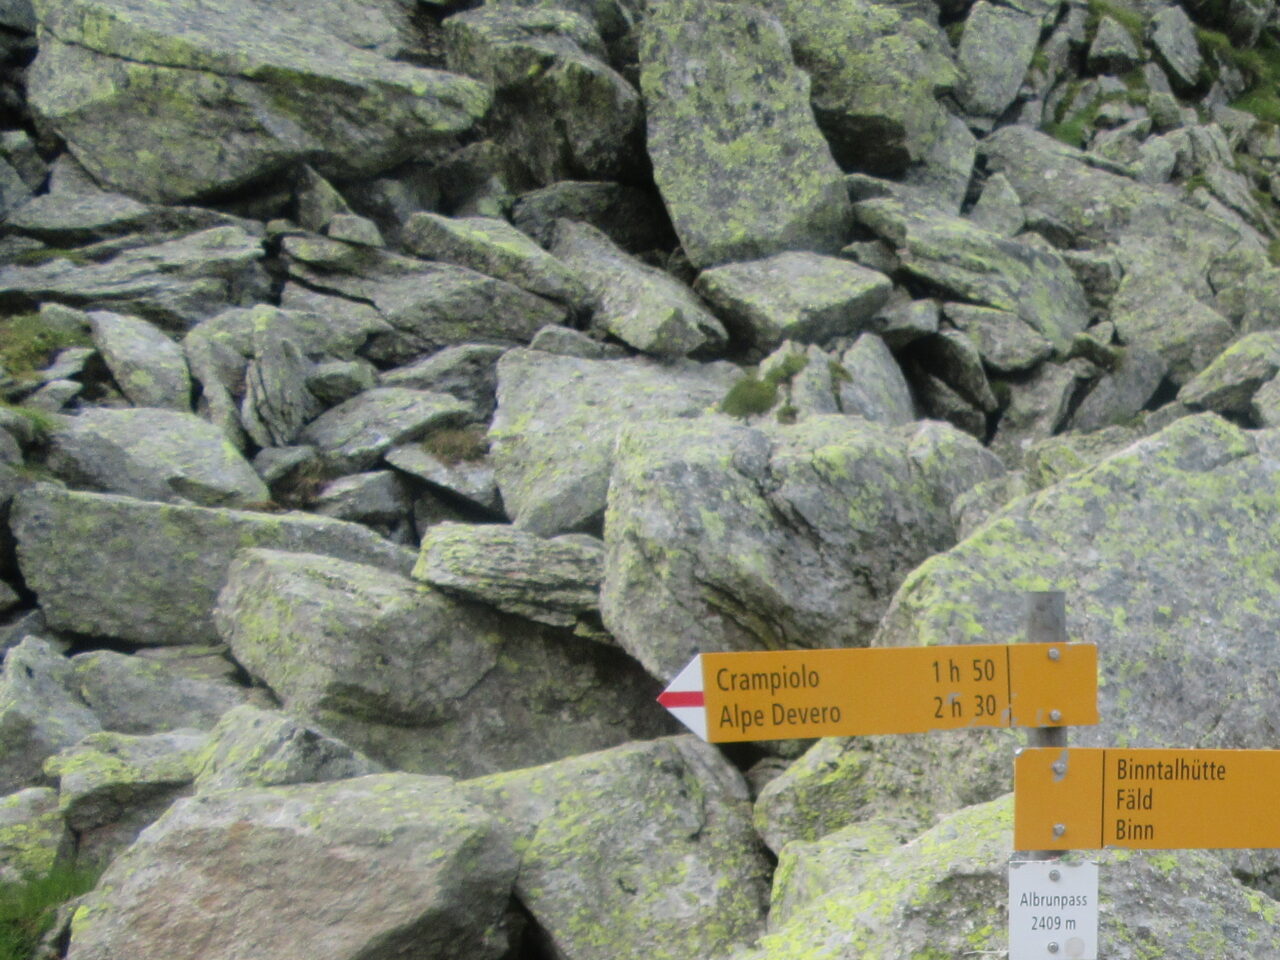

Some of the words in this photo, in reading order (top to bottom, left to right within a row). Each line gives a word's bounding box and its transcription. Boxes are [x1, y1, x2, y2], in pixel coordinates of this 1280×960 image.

[716, 663, 820, 697] Crampiolo
[932, 660, 940, 683] 1
[949, 659, 961, 683] h
[972, 658, 995, 682] 50
[719, 703, 764, 734] Alpe
[771, 702, 841, 726] Devero
[933, 695, 944, 719] 2
[950, 694, 962, 717] h
[974, 694, 997, 717] 30
[1117, 757, 1226, 781] Binntalhütte
[1116, 787, 1153, 810] Fäld
[1115, 818, 1154, 841] Binn
[1019, 891, 1088, 910] Albrunpass
[1031, 915, 1062, 931] 2409
[1064, 918, 1077, 931] m
